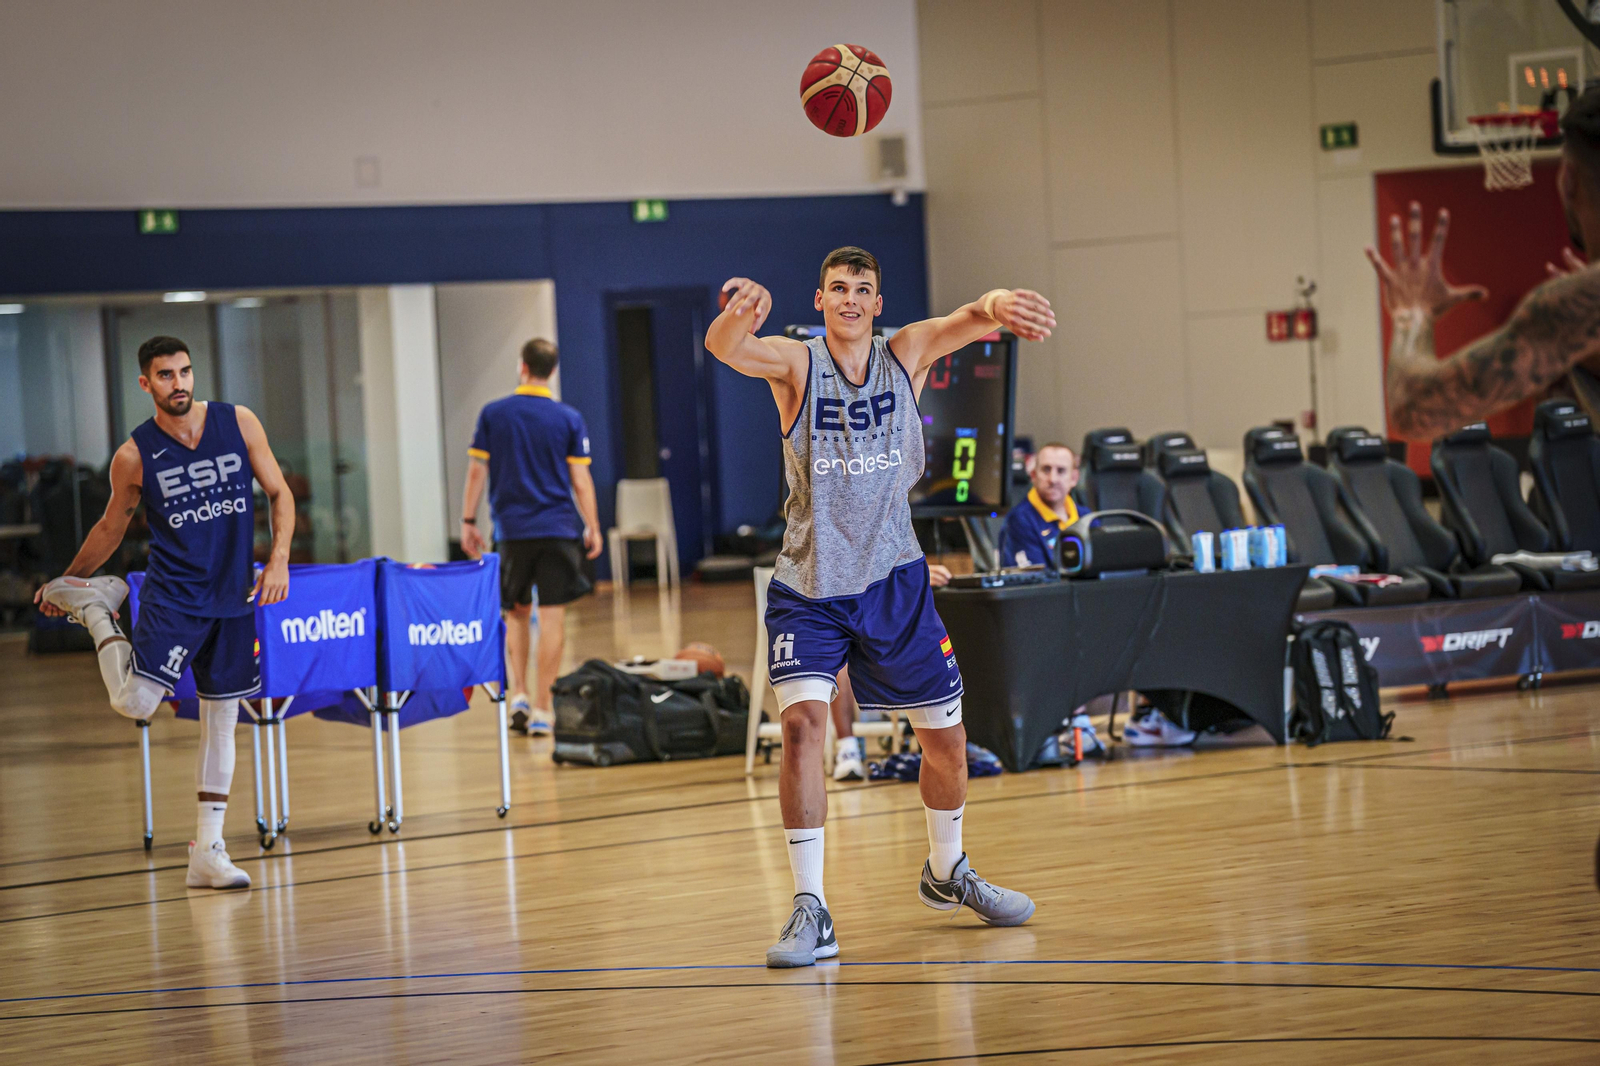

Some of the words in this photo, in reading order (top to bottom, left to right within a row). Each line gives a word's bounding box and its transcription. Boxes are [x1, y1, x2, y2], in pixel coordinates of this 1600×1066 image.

[815, 390, 896, 431] ESP
[811, 426, 902, 442] BASKETBALL
[156, 452, 242, 499] ESP
[813, 448, 902, 475] endesa
[168, 497, 247, 529] endesa
[281, 607, 367, 643] molten
[408, 619, 483, 646] molten
[168, 645, 189, 673] fi
[773, 633, 795, 662] fi
[771, 658, 801, 671] network
